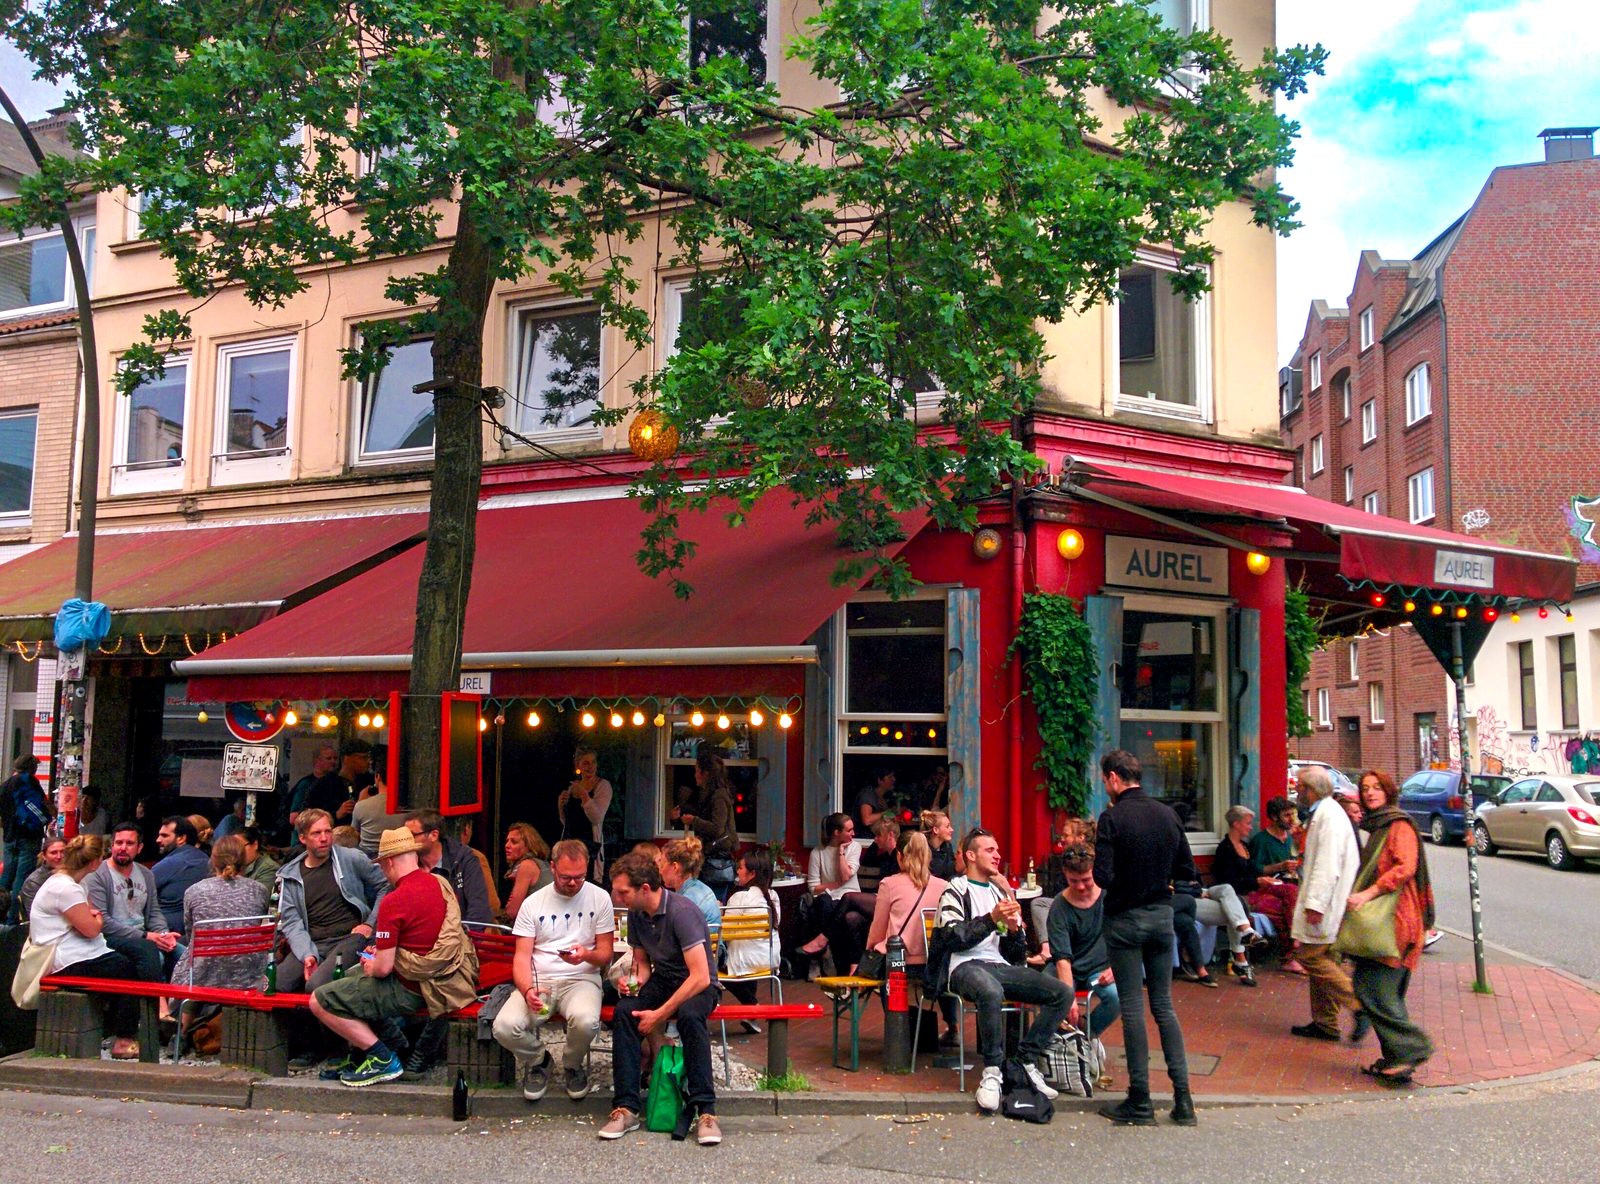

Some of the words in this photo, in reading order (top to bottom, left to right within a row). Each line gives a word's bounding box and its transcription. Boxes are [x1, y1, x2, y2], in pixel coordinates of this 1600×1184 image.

[1126, 548, 1212, 583] AUREL
[1443, 559, 1486, 581] AUREL
[460, 677, 484, 690] UREL
[228, 754, 248, 764] Mo-Fr
